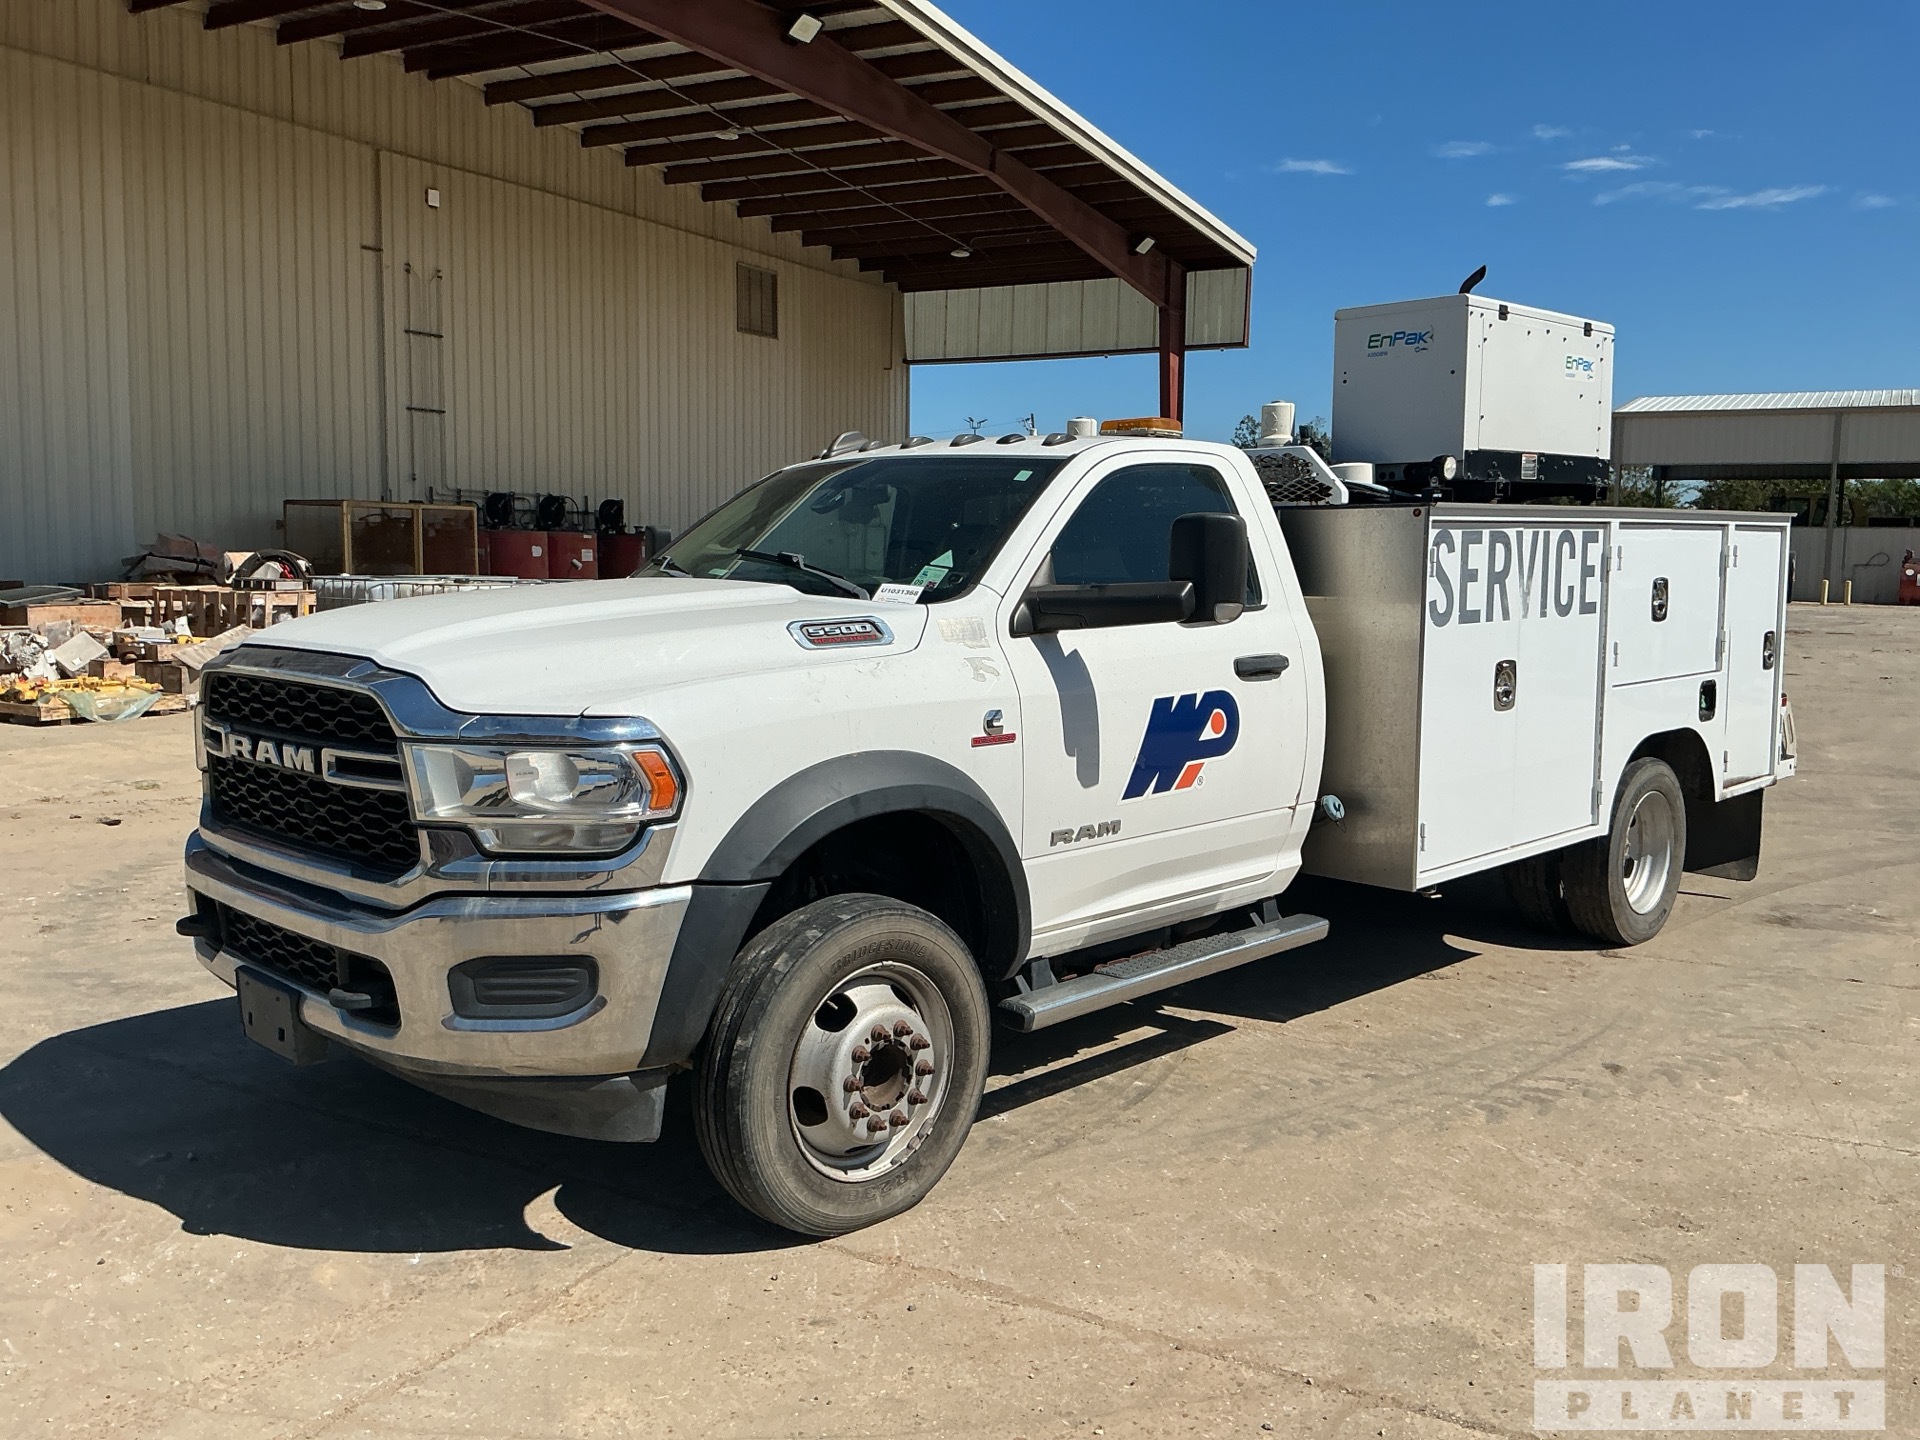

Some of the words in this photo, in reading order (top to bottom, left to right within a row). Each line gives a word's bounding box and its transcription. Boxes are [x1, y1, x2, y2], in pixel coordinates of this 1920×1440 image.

[1368, 331, 1430, 349] EnPak
[1566, 356, 1594, 372] EnPak
[1428, 528, 1599, 627] SERVICE
[807, 624, 871, 637] 5500
[228, 734, 315, 774] RAM
[1050, 819, 1122, 847] RAM
[831, 939, 928, 975] BRIDGESTONE
